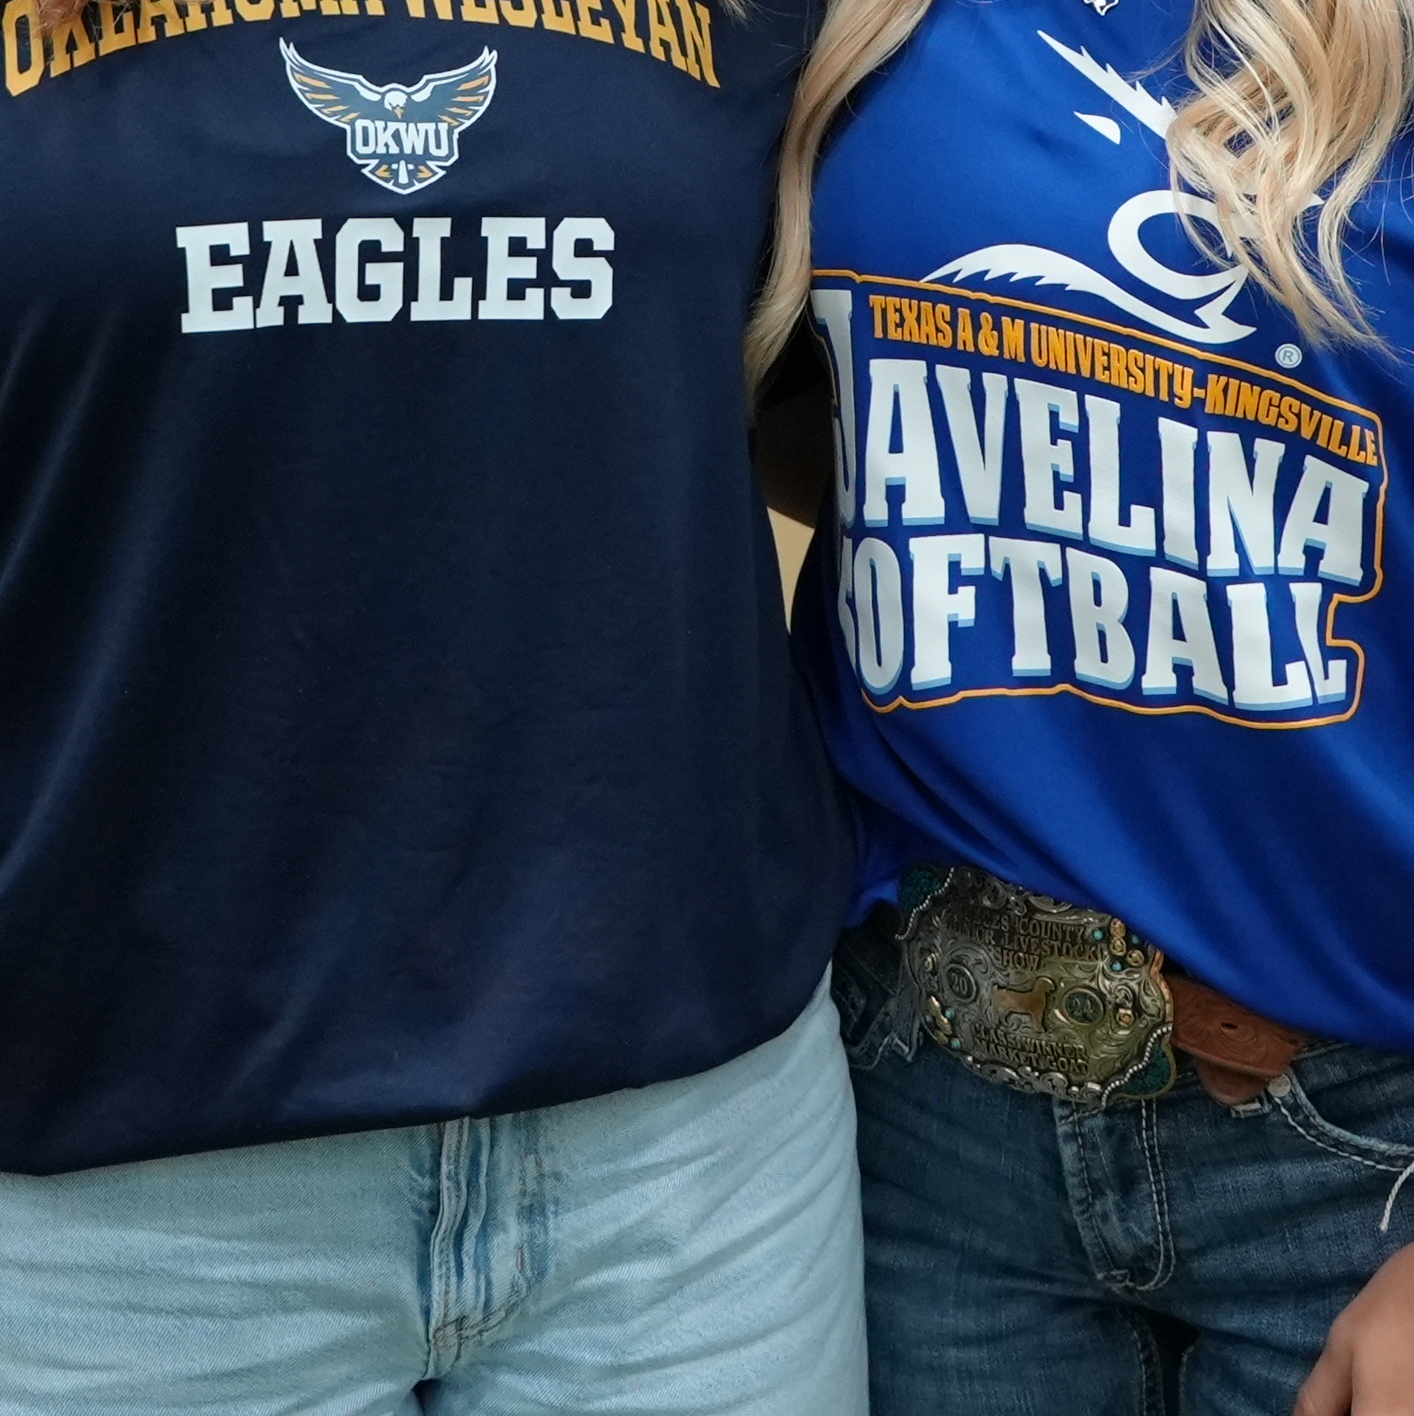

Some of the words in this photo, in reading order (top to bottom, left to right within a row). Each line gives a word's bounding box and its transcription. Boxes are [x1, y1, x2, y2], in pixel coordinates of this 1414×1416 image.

[355, 118, 450, 159] OKWU
[176, 217, 616, 334] EAGLES
[811, 288, 1371, 587] JAVELINA
[868, 294, 953, 349] TEXAS
[956, 307, 975, 353] A
[977, 311, 1000, 357] &
[1001, 315, 1026, 363] M
[1029, 321, 1379, 467] UNIVERSITY-KINGSVILLE
[1018, 918, 1085, 942] COUNTY
